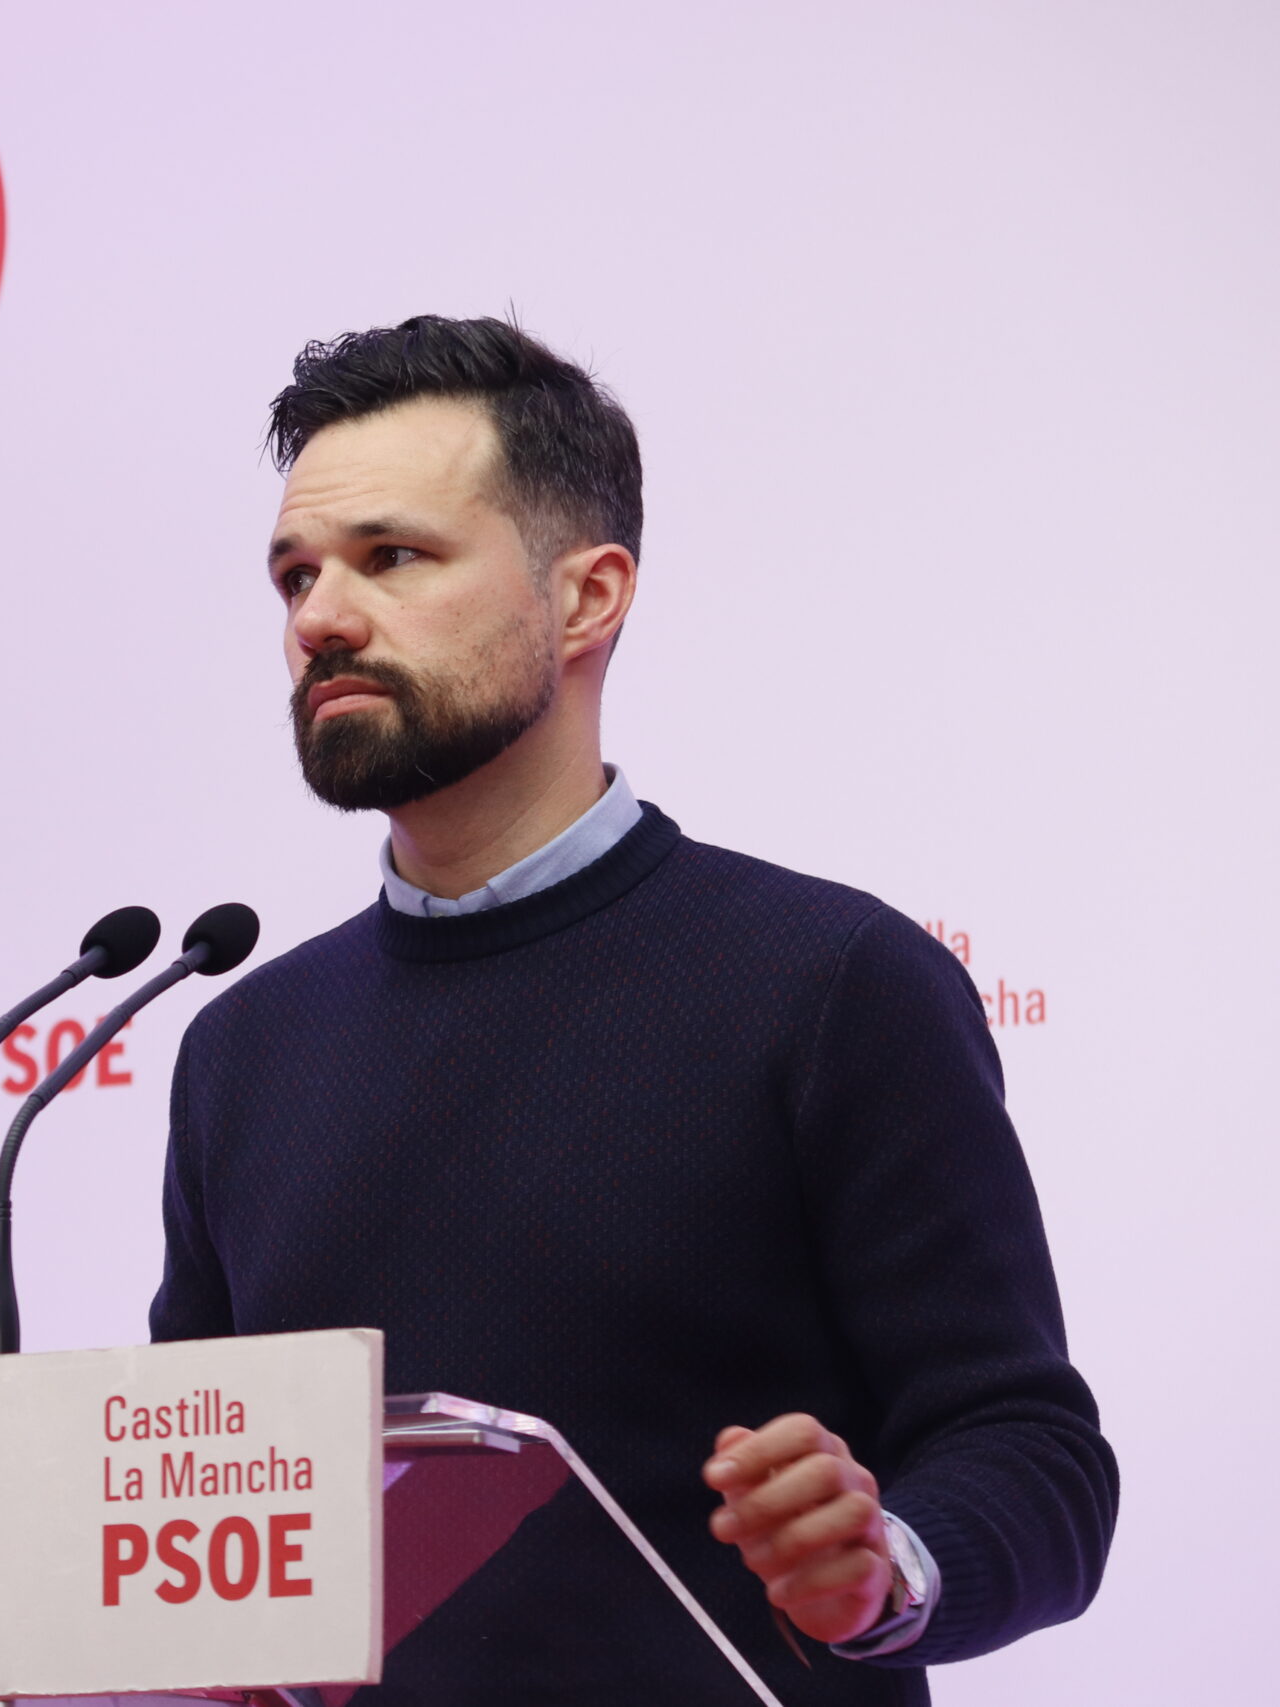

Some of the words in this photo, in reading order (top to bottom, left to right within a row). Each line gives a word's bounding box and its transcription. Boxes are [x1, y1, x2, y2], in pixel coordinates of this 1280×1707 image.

[104, 1389, 246, 1442] Castilla
[104, 1457, 144, 1502] La
[161, 1446, 314, 1499] Mancha
[102, 1512, 314, 1607] PSOE
